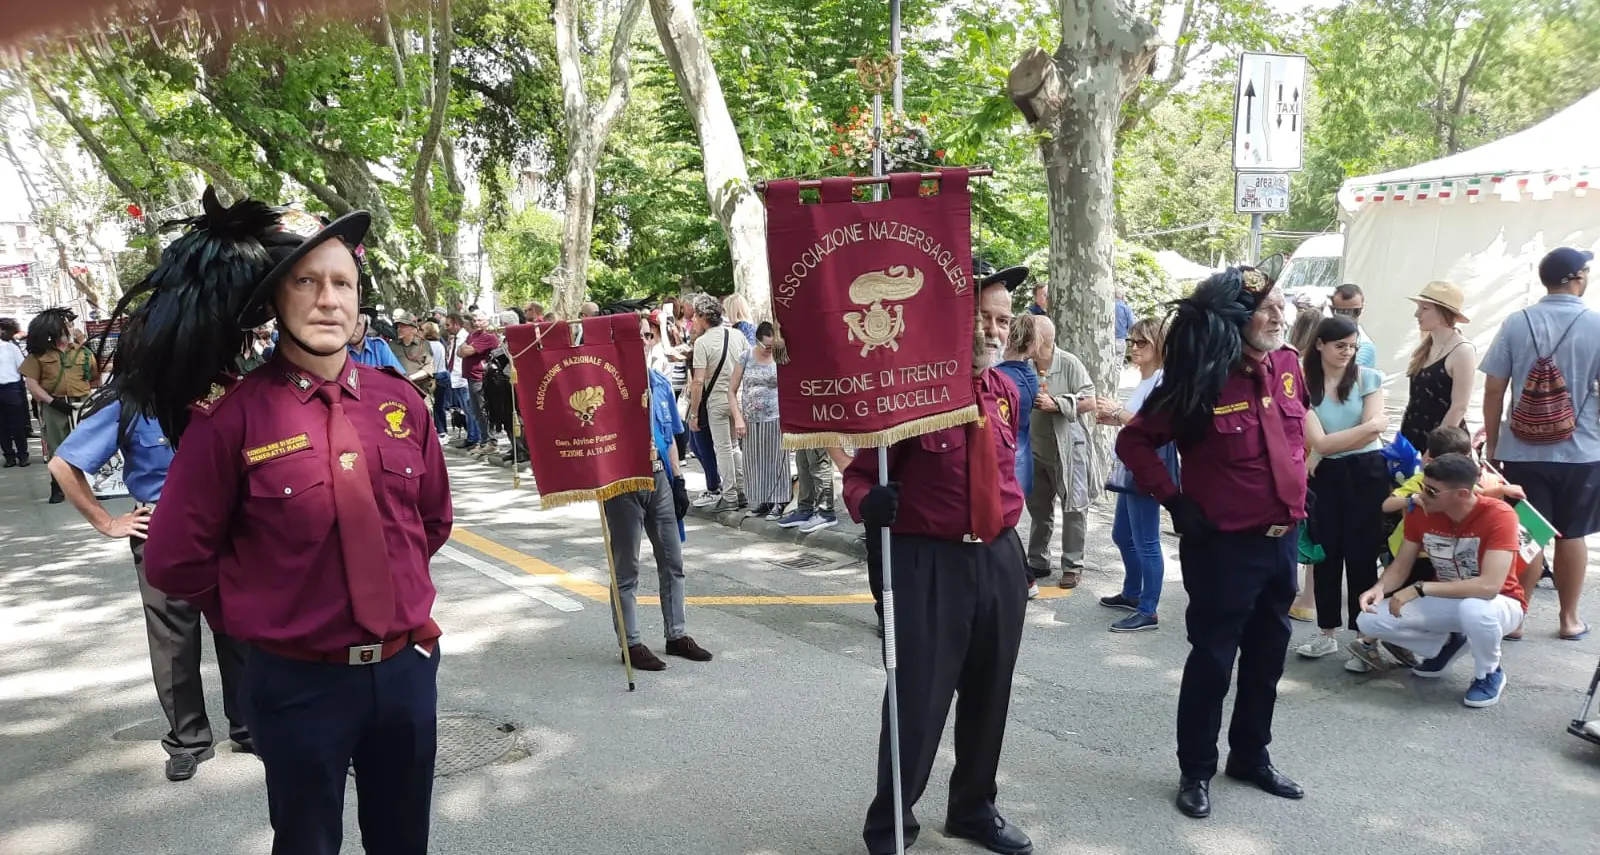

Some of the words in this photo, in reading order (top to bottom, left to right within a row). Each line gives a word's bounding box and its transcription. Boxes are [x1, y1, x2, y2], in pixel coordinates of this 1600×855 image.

[1277, 103, 1299, 113] TAXI
[1256, 177, 1272, 188] area
[775, 223, 864, 308] ASSOCIAZIONE
[536, 363, 562, 411] ASSOCIAZIONE
[562, 355, 602, 368] NAZIONALE
[800, 372, 875, 396] SEZIONE
[880, 369, 895, 388] DI
[899, 359, 958, 386] TRENTO
[812, 403, 849, 422] M.O.
[877, 386, 950, 414] BUCCELLA
[560, 449, 584, 458] SEZIONE
